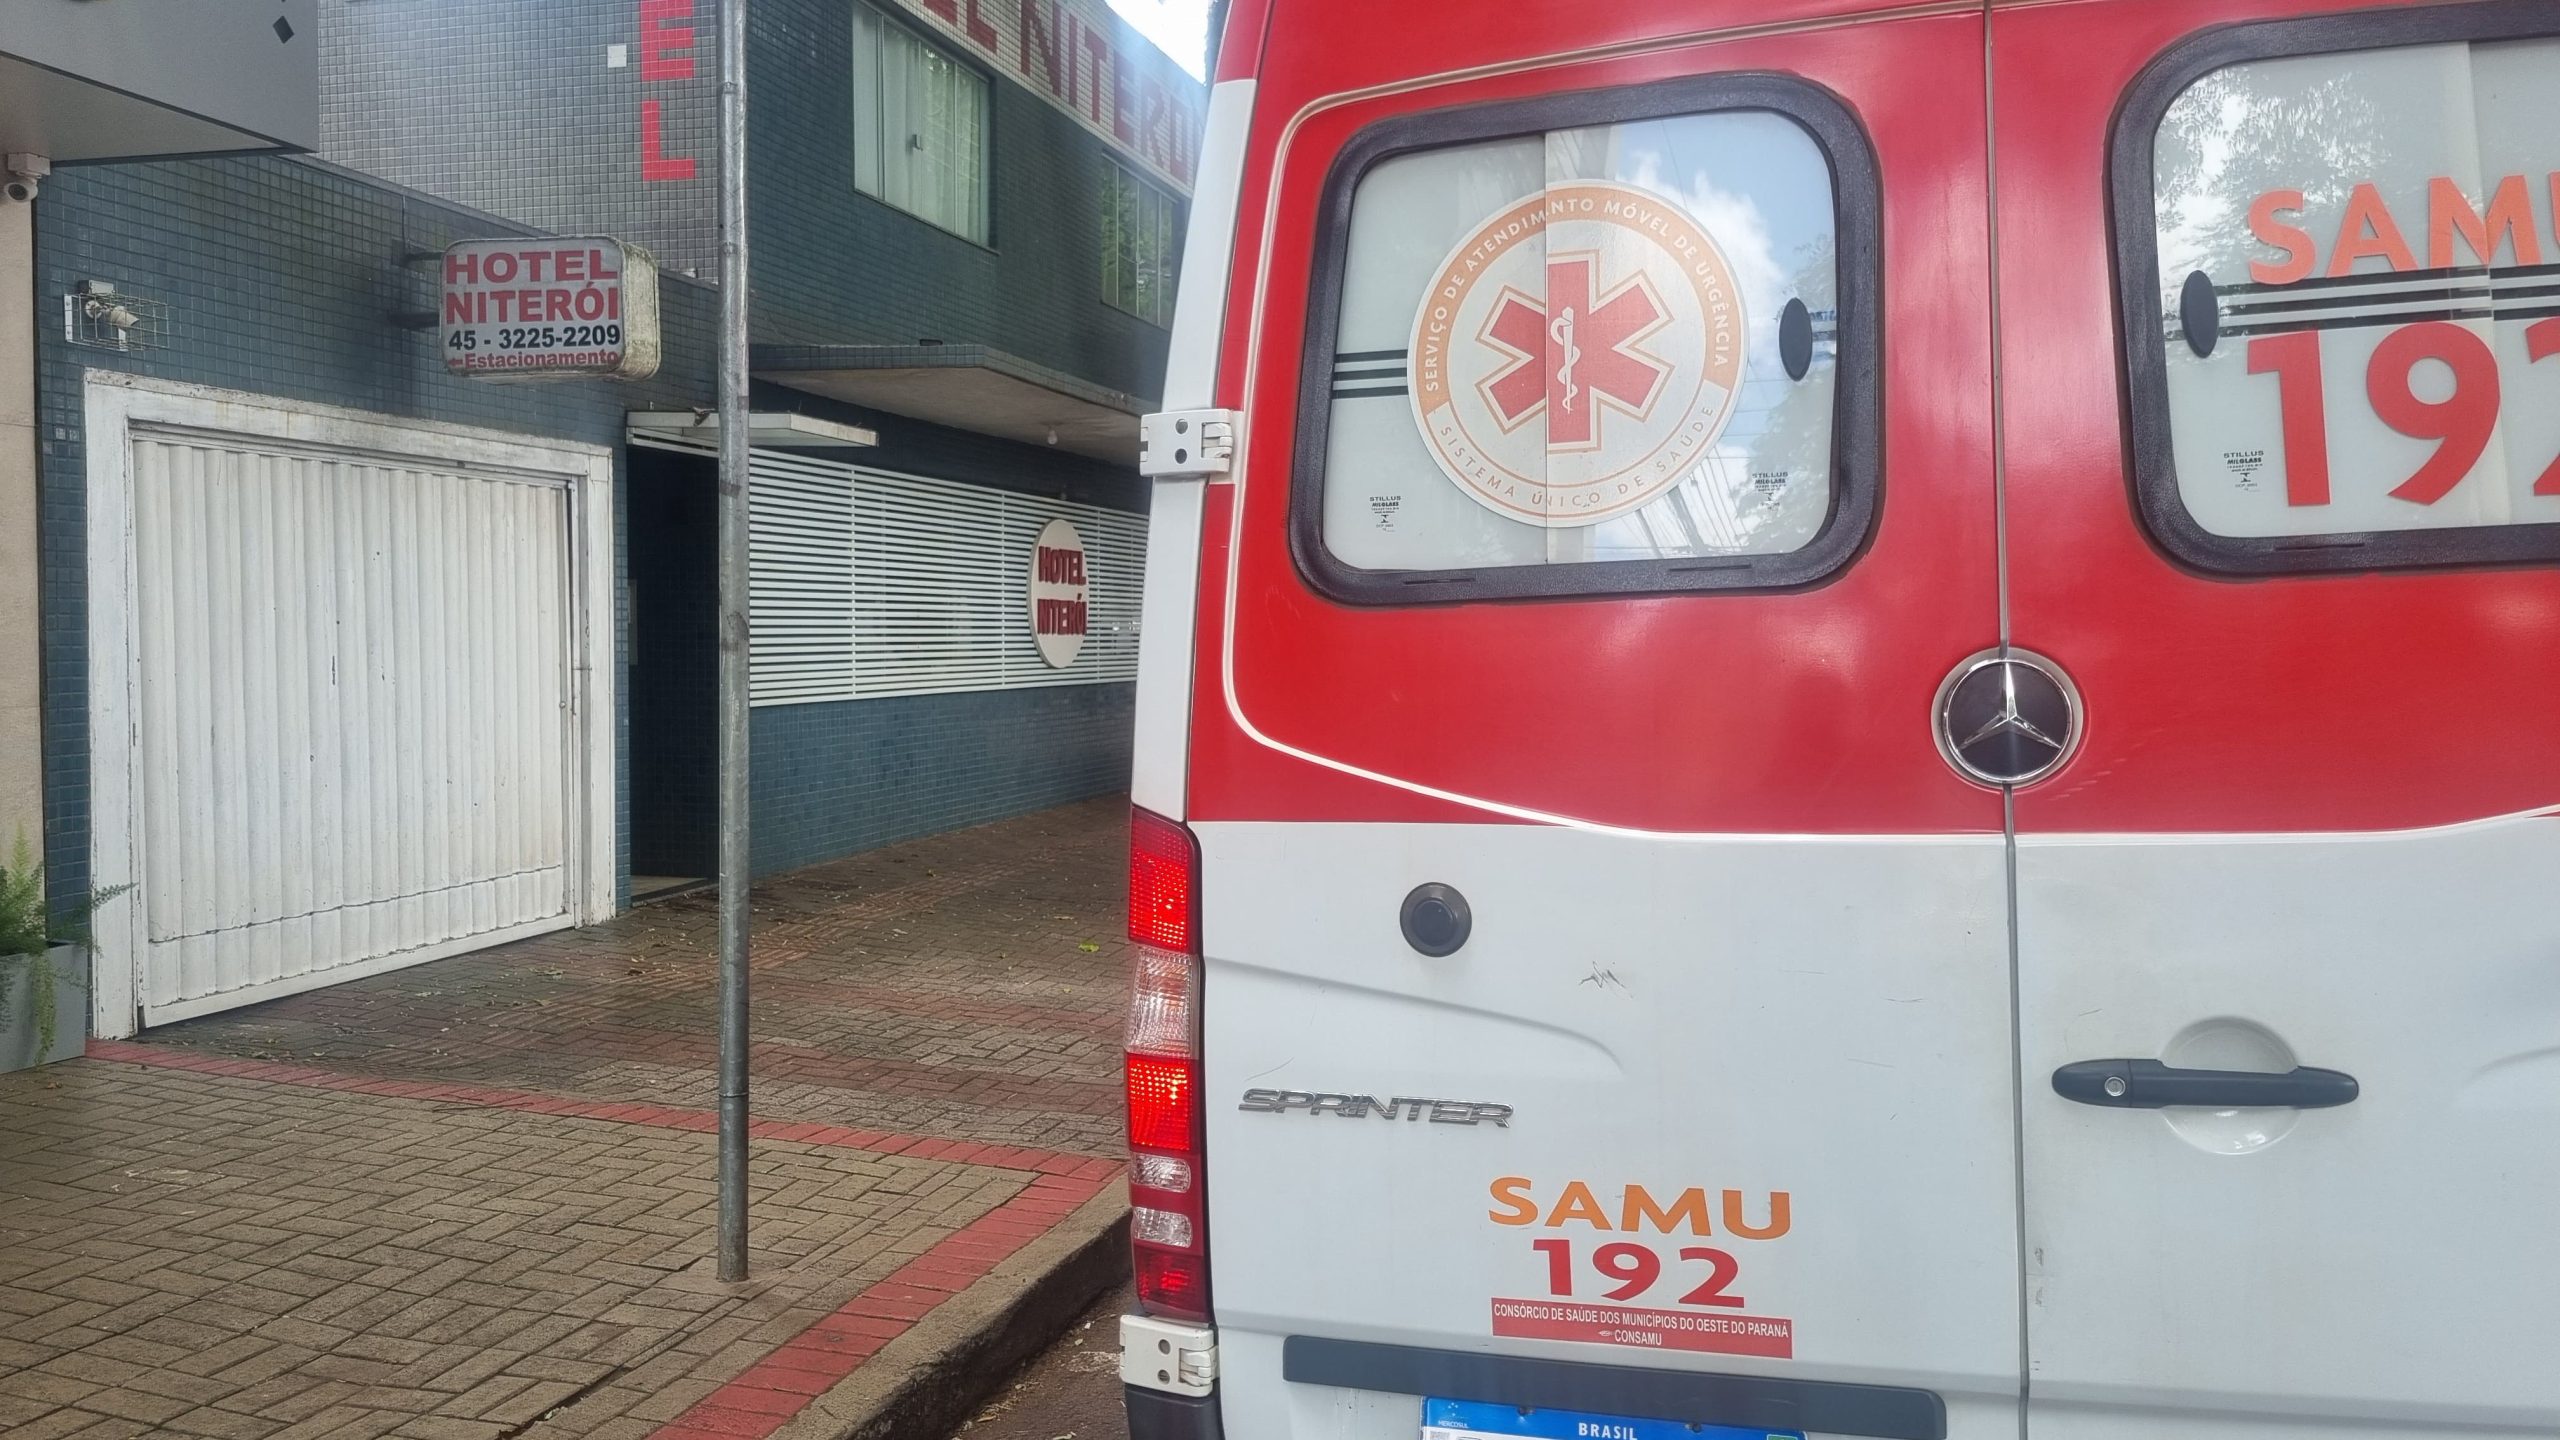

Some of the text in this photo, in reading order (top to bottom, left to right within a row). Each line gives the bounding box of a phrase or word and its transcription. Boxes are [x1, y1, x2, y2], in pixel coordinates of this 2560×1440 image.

[2247, 172, 2560, 285] SAM
[446, 250, 618, 284] HOTEL
[446, 281, 618, 324] NITERÓI
[1424, 198, 1730, 392] SERVIÇO DE ATENDIMNTO MÓVEL DE URGÊNCIA
[449, 330, 476, 351] 45
[499, 325, 620, 349] 3225-2209
[465, 350, 619, 368] Estacionamento
[2247, 316, 2560, 507] 19
[1440, 407, 1714, 507] SISTEMA ÚNICO DE SAÚDE
[1038, 546, 1086, 585] HOTEL
[1239, 1088, 1514, 1128] SPRINTER
[1488, 1177, 1791, 1240] SAMU
[1533, 1239, 1745, 1308] 192
[1494, 1302, 1789, 1338] CONSÓRCIO DE SAÚDE DOS MUNICÍPIOS DO OESTE DO PARANÁ
[1614, 1329, 1662, 1346] CONSAMU
[1578, 1422, 1638, 1440] BRASIL
